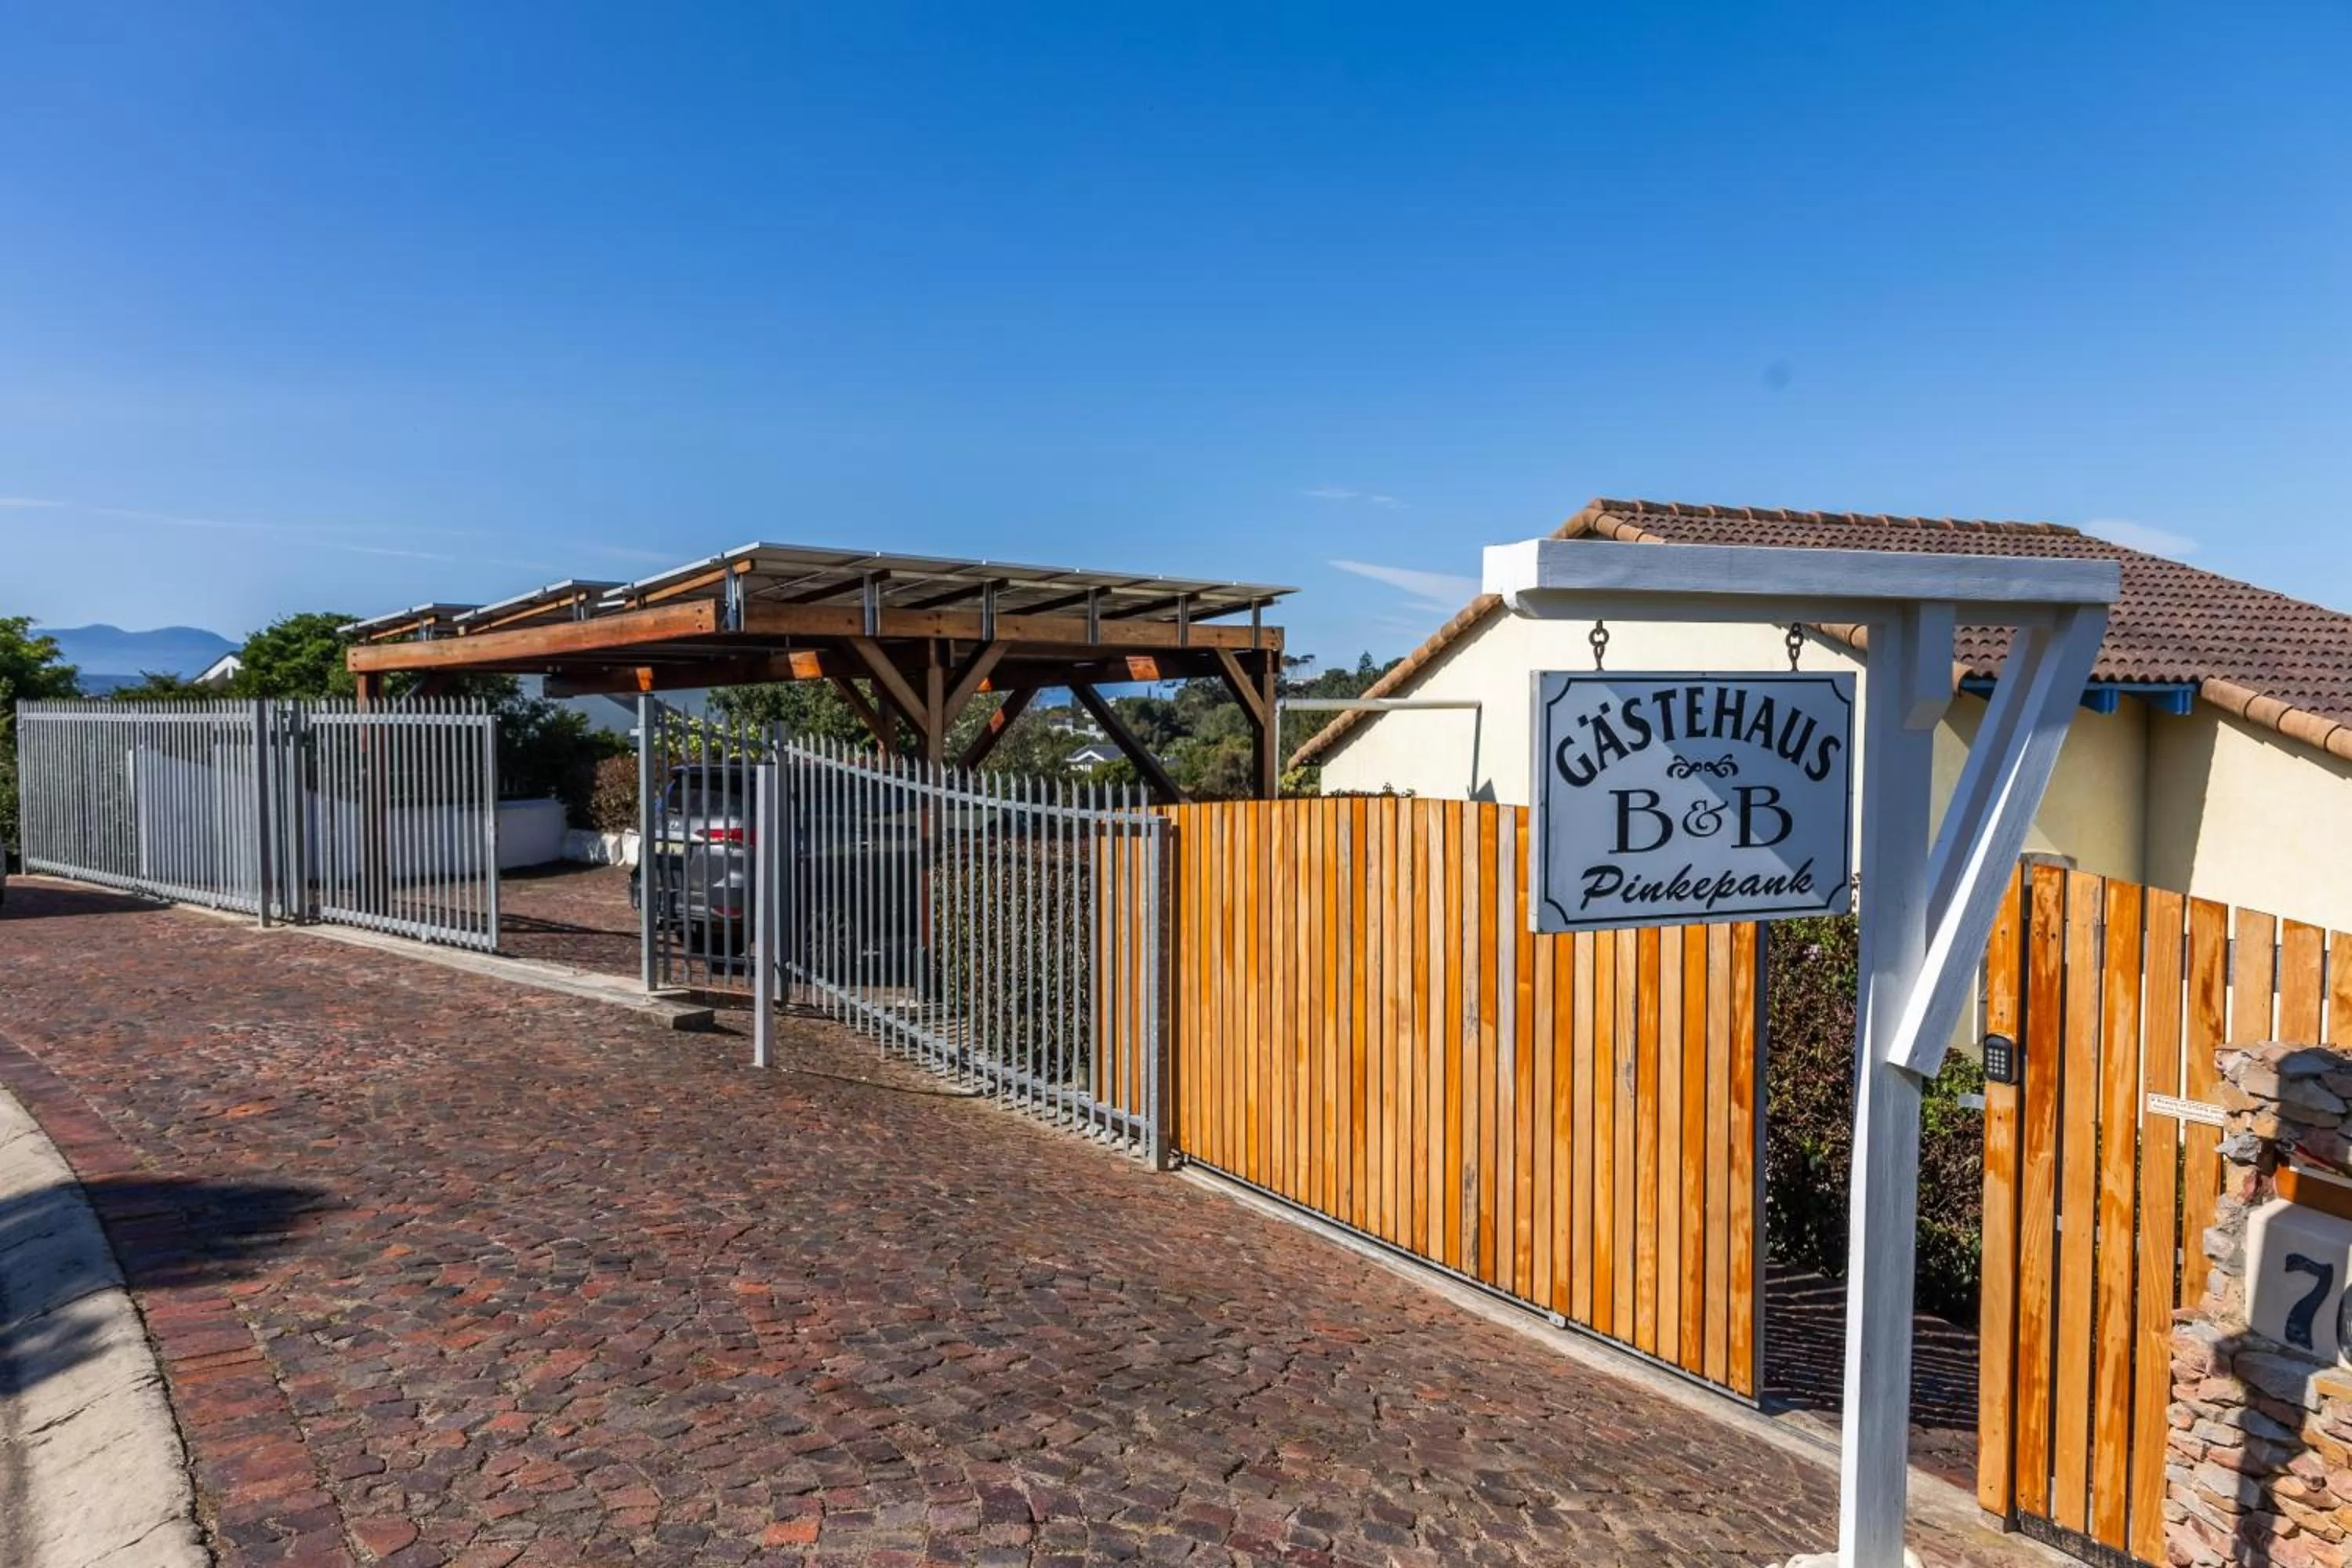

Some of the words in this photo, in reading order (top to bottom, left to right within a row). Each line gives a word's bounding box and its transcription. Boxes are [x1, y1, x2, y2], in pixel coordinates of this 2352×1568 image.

[1555, 686, 1842, 787] GÄSTEHAUS
[1608, 786, 1793, 854] B&B
[1580, 857, 1814, 910] Pinkepank
